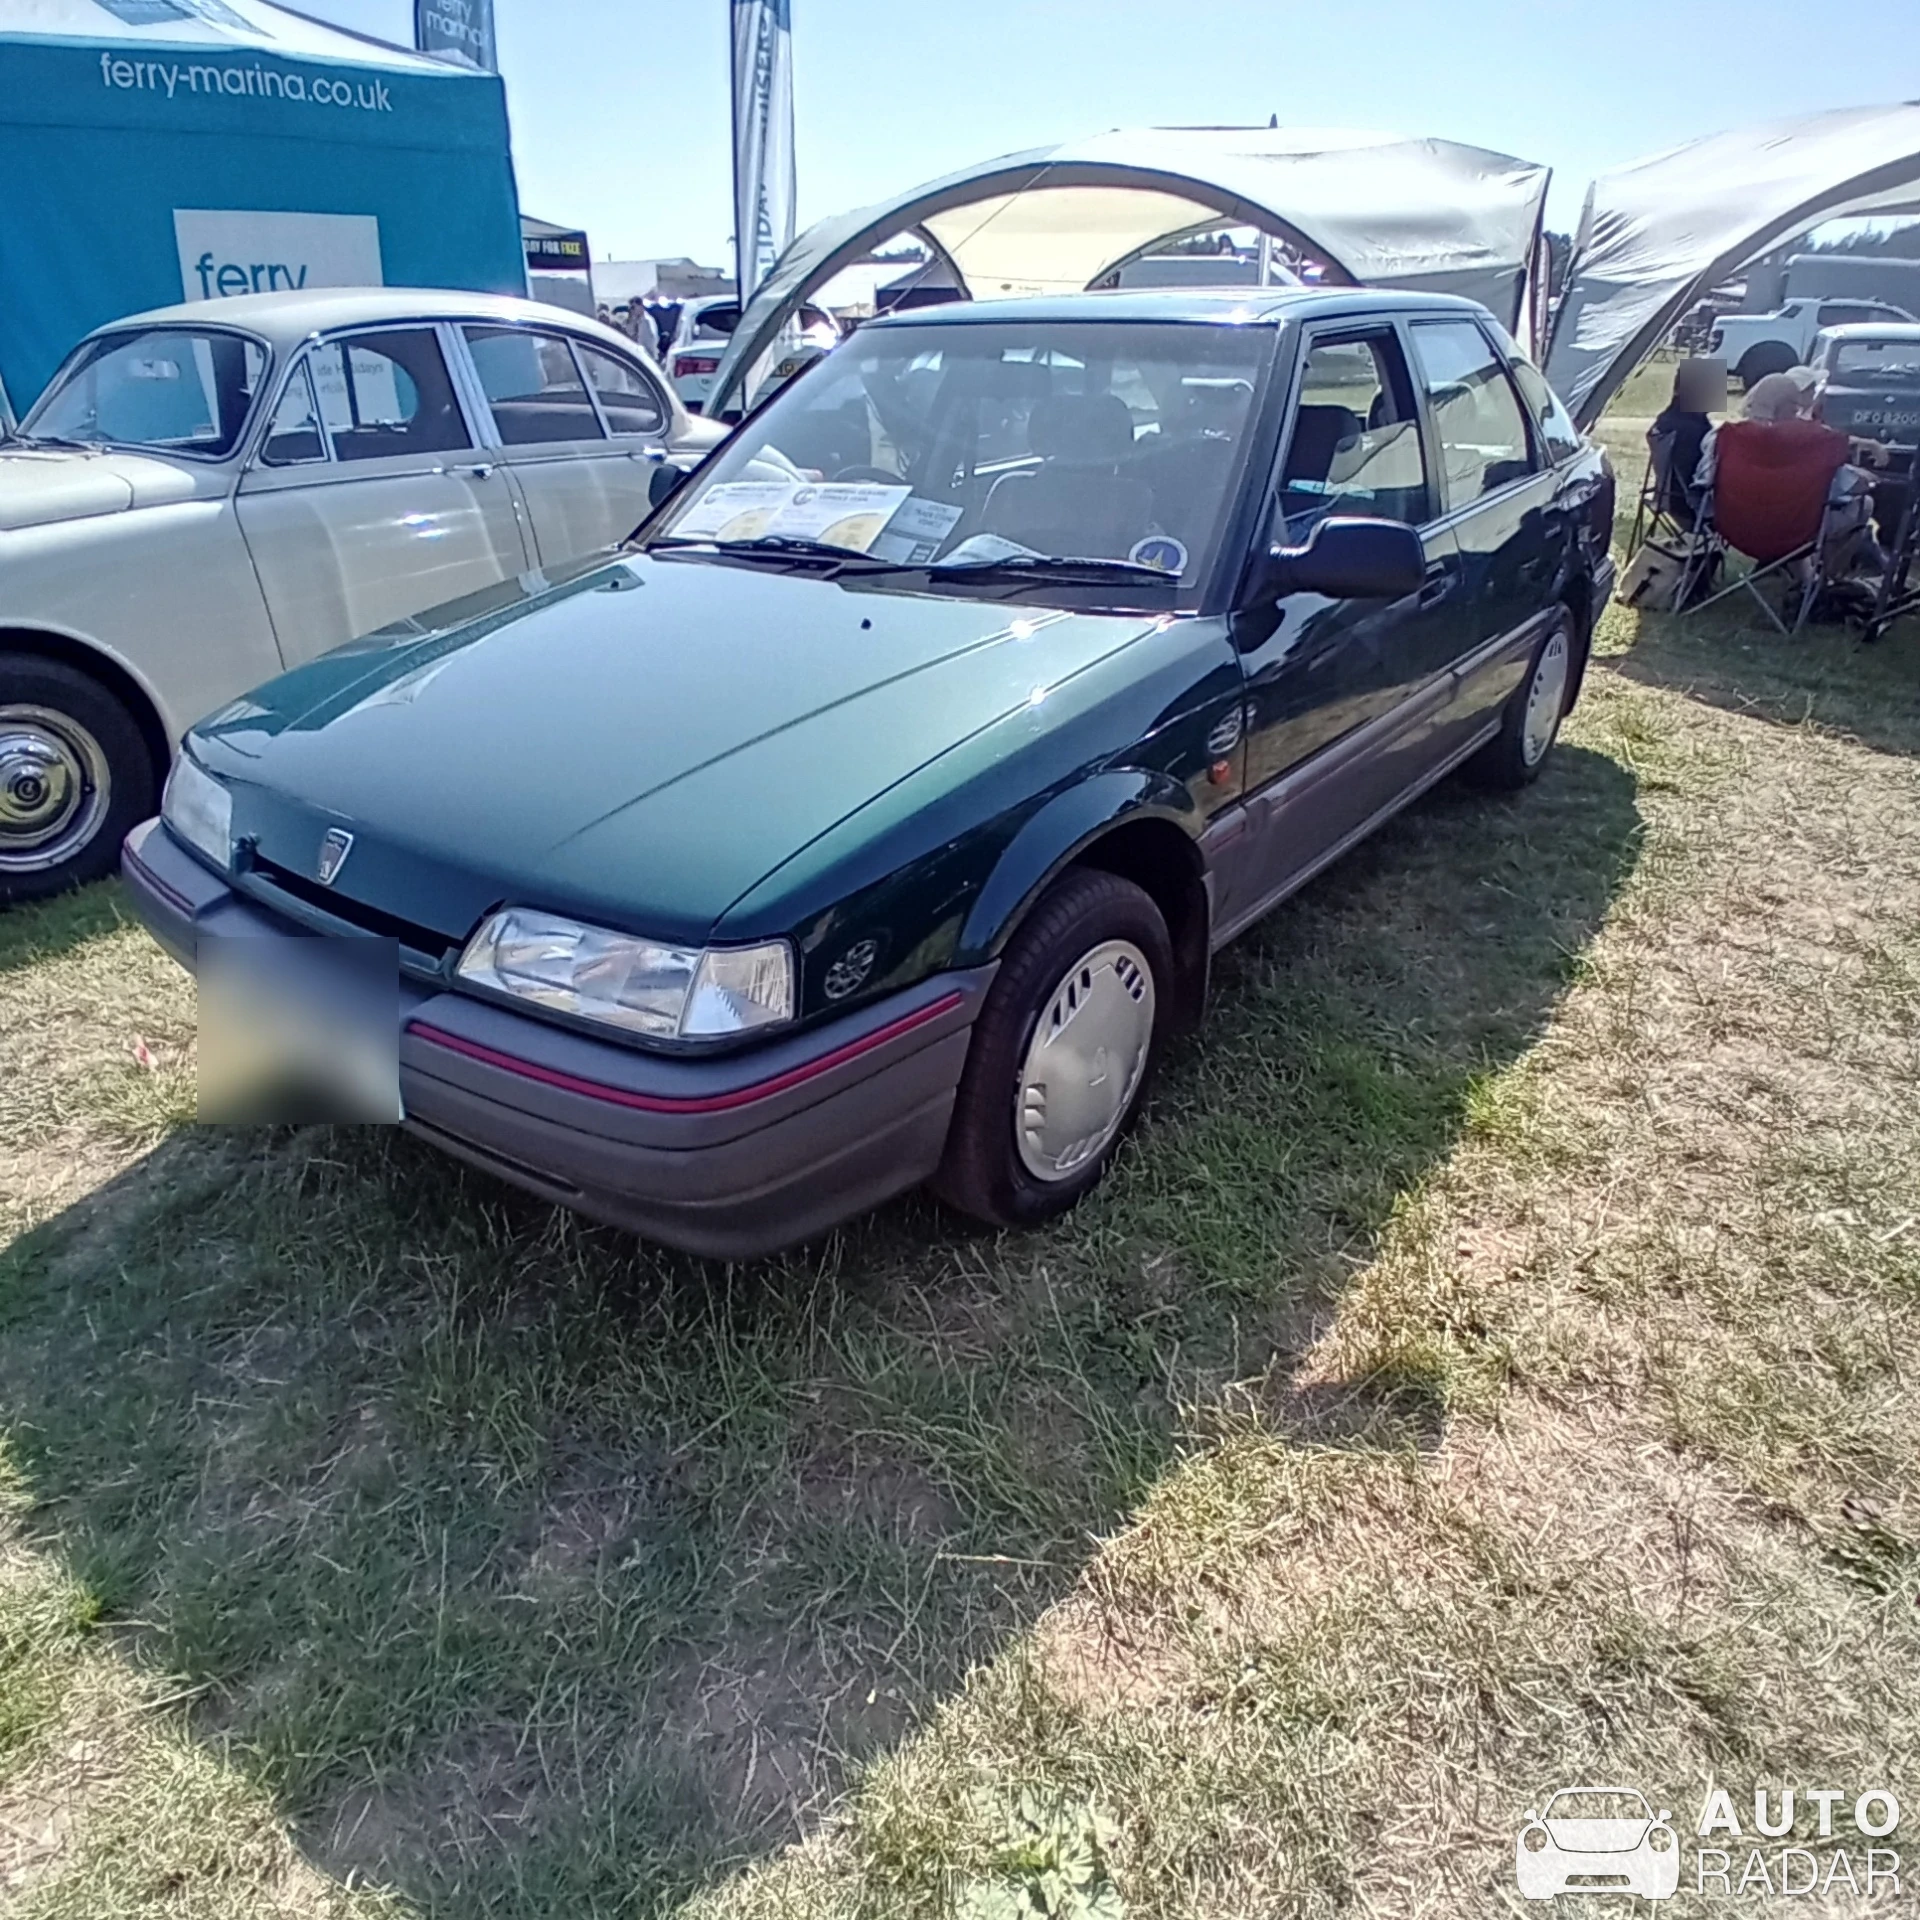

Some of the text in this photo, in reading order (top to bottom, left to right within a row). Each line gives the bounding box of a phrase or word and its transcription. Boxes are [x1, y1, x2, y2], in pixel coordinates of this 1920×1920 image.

[426, 10, 482, 46] marina
[100, 52, 393, 112] ferry-marina.co.uk
[542, 241, 560, 255] FOR
[560, 242, 582, 256] FREE
[195, 252, 307, 300] ferry
[335, 361, 384, 376] Hlidays
